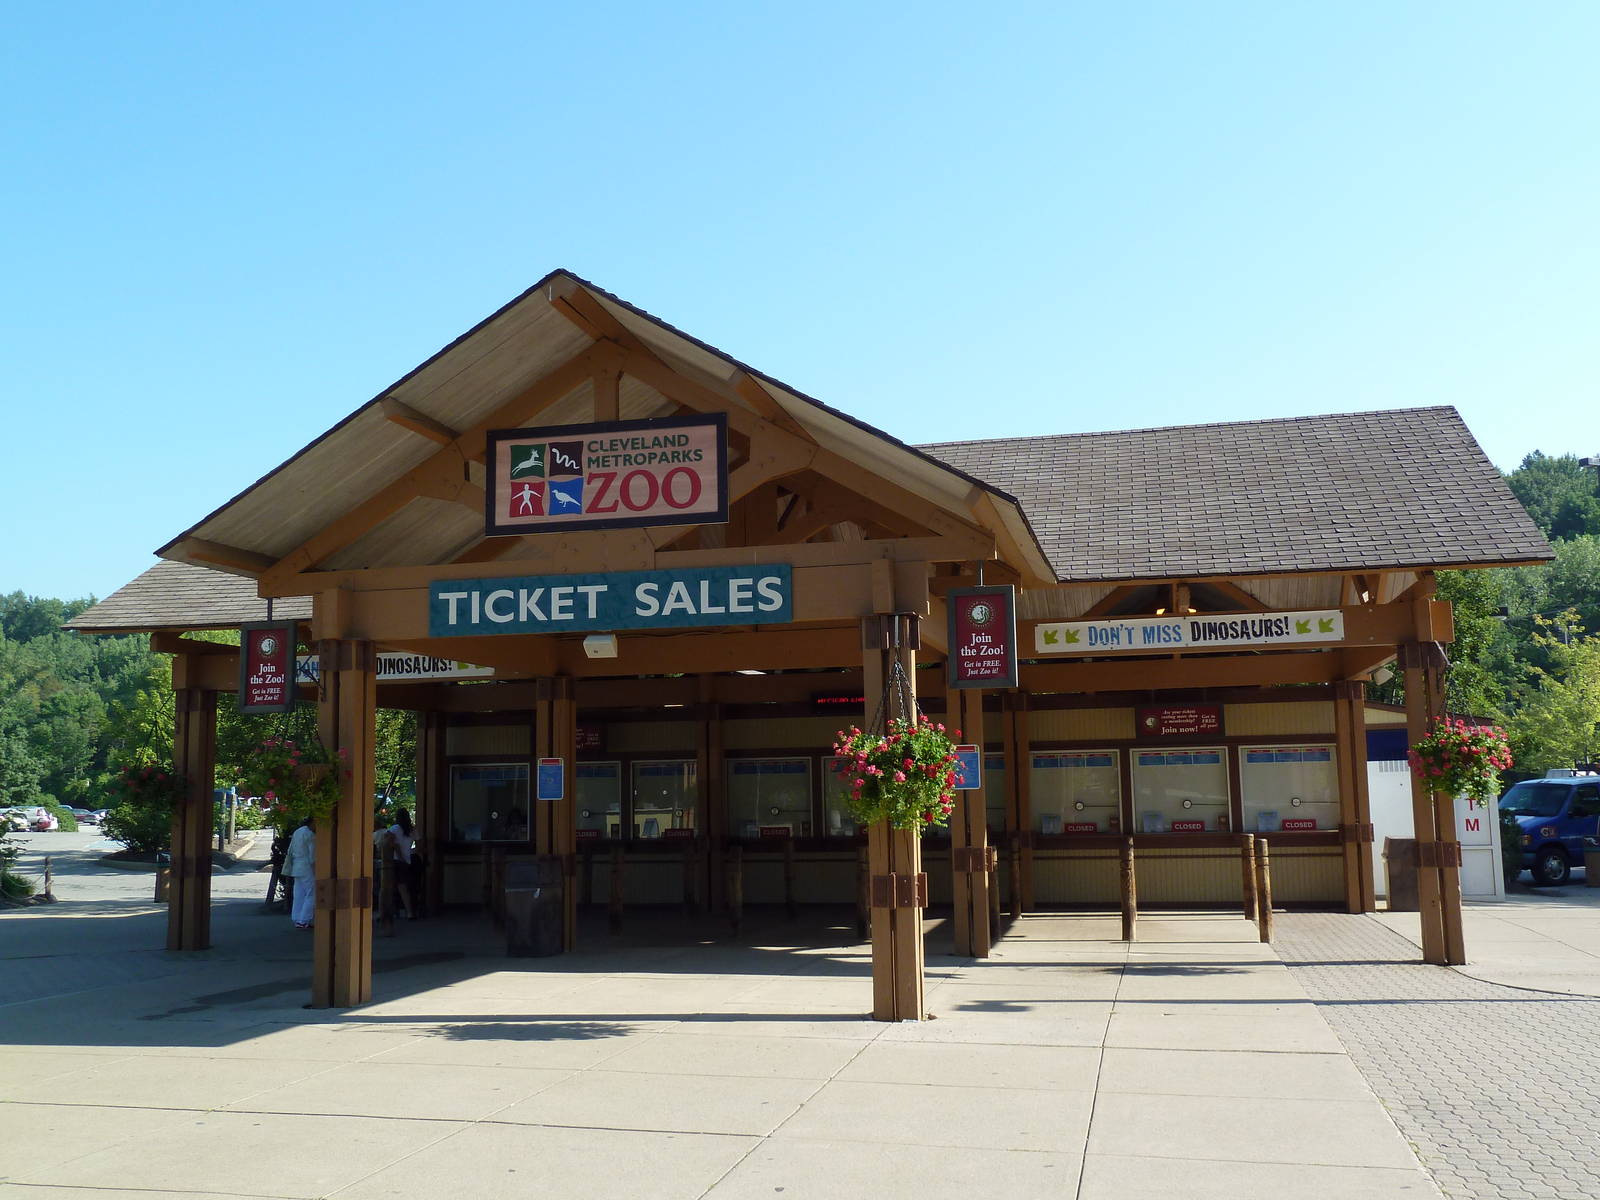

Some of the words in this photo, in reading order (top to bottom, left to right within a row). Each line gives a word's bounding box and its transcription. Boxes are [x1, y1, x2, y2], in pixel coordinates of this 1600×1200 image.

[587, 434, 690, 453] CLEVELAND
[587, 448, 704, 469] METROPARKS
[585, 466, 703, 514] ZOO
[438, 584, 608, 625] TICKET
[635, 576, 784, 617] SALES
[1087, 624, 1135, 647] DON'T
[1143, 624, 1182, 645] MISS
[1190, 616, 1290, 642] DINOSAURS!
[971, 633, 992, 646] Join
[961, 646, 977, 656] the
[980, 645, 1004, 656] Zoo!
[258, 663, 276, 675] Join
[376, 656, 453, 675] DINOSAURS!
[967, 668, 978, 677] Just
[250, 675, 263, 684] the
[265, 674, 285, 684] Zoo!
[1161, 726, 1177, 735] Join
[1179, 725, 1198, 733] now!
[1068, 824, 1094, 833] CLOSED
[1174, 822, 1201, 831] CLOSED
[1285, 820, 1313, 829] CLOSED
